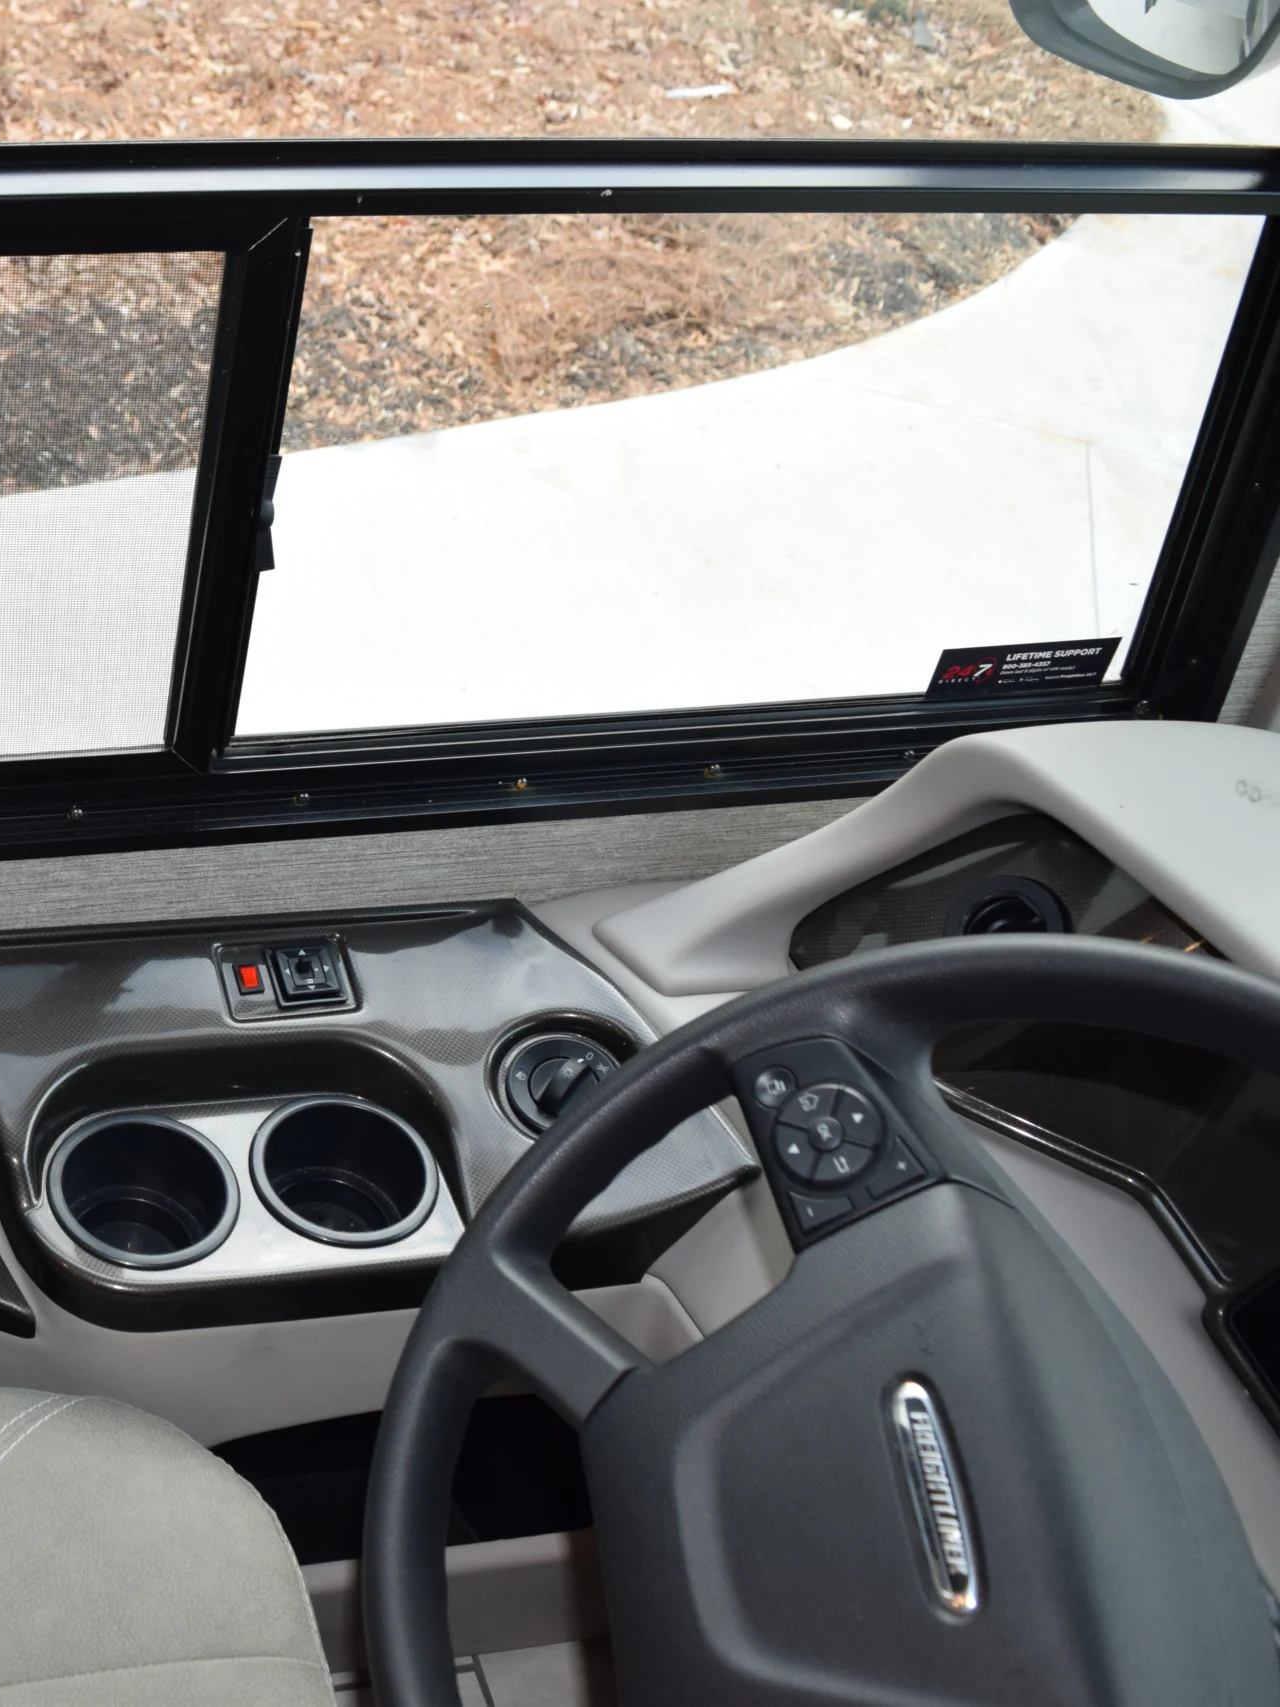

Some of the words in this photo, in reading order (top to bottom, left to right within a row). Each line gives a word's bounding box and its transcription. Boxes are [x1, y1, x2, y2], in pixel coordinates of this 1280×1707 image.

[1006, 651, 1052, 662] LIFETIME
[1054, 647, 1102, 658] SUPPORT
[909, 1411, 969, 1576] FREIGHTLINER
